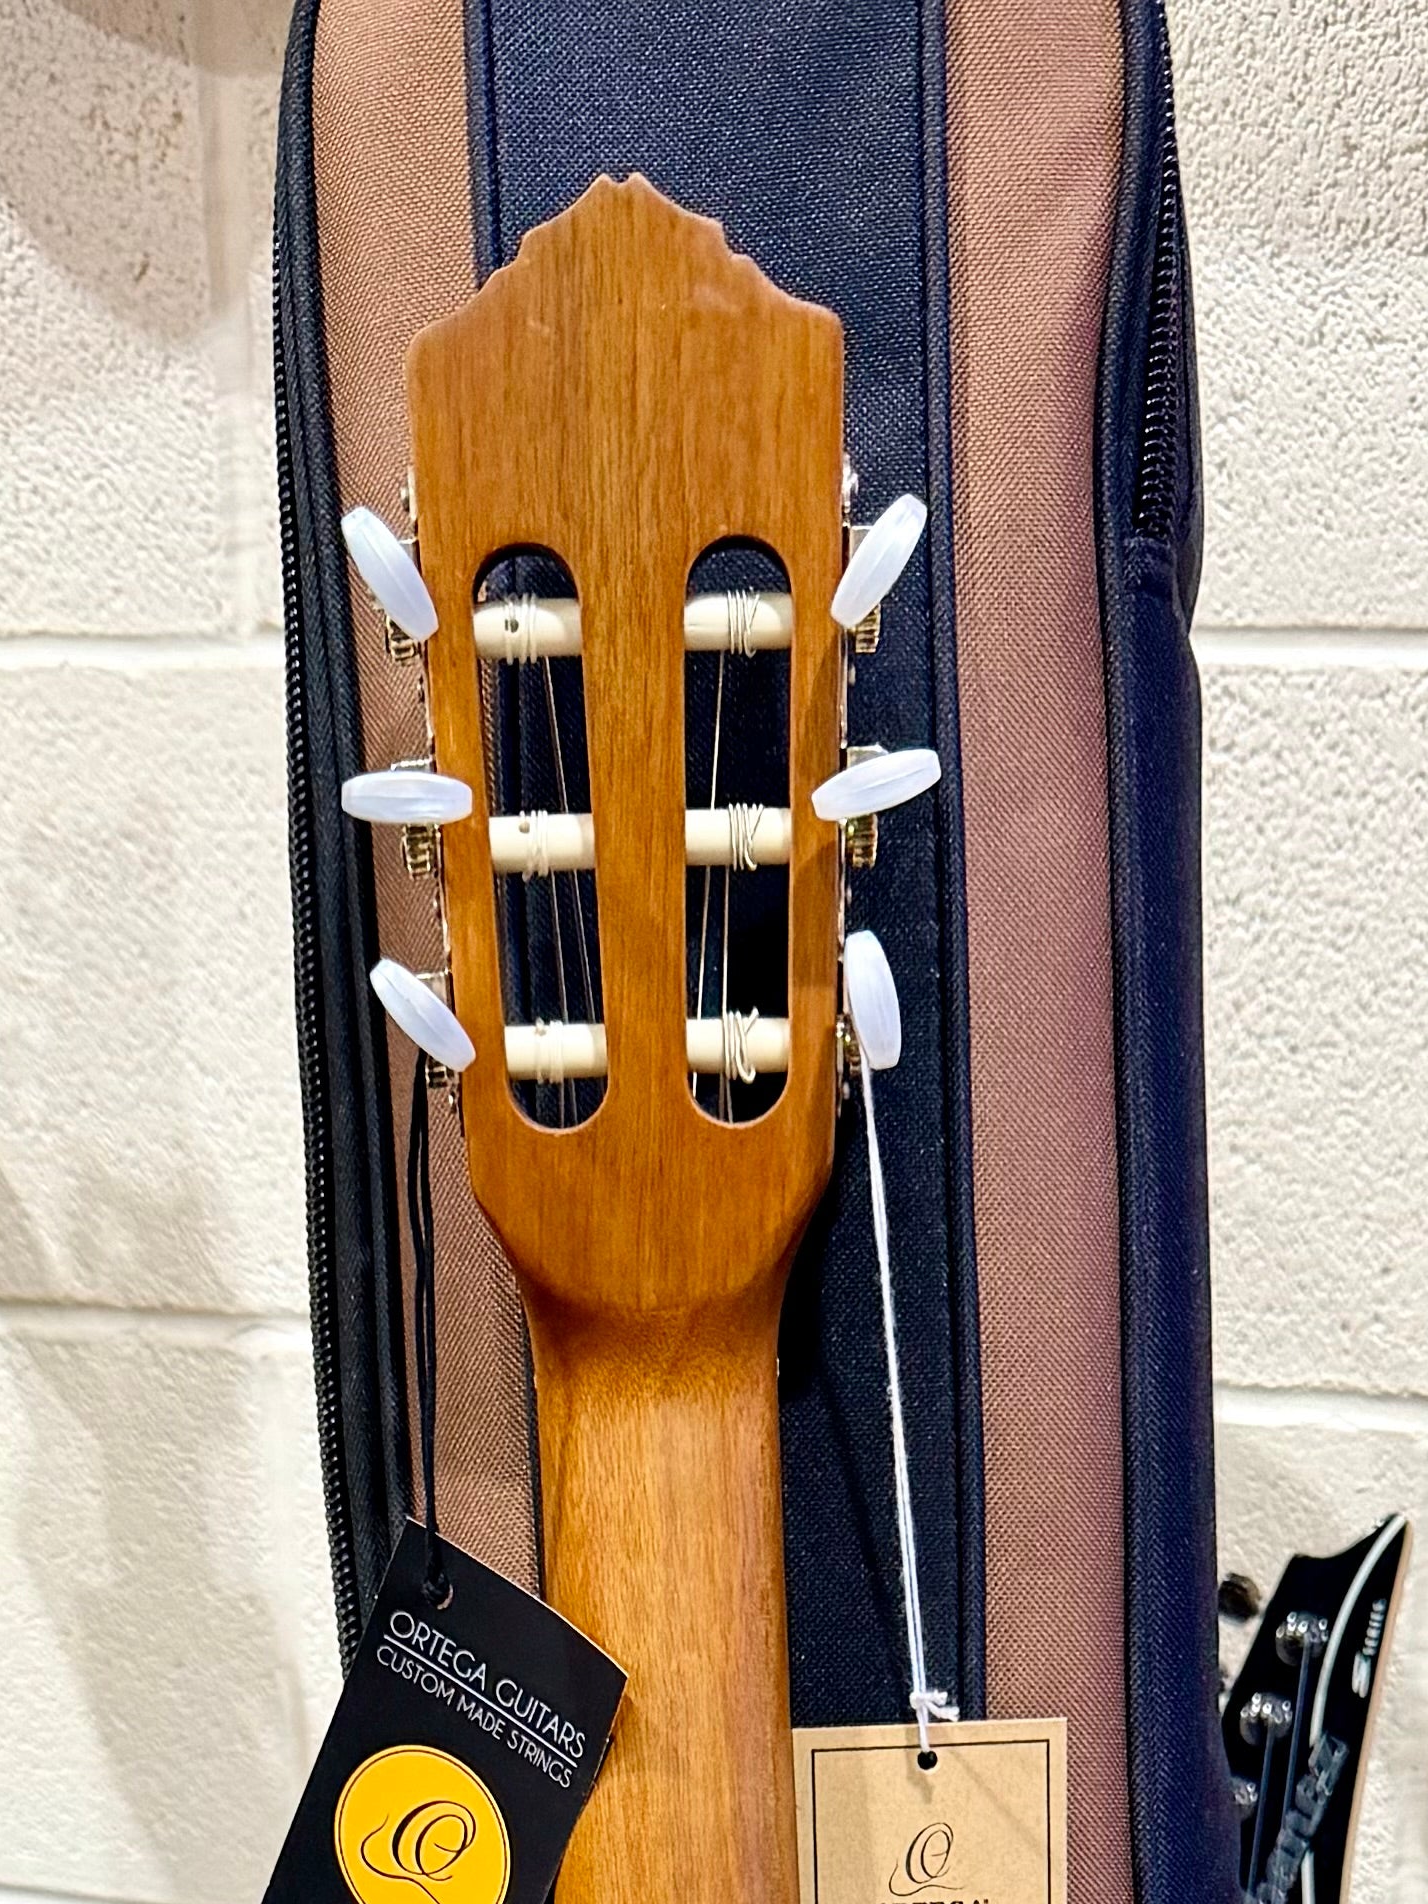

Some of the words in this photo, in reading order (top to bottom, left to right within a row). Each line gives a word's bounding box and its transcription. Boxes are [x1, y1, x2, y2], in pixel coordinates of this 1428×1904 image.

[376, 1647, 454, 1709] CUSTOM
[456, 1694, 505, 1740] MADE
[506, 1728, 574, 1790] STRINGS
[389, 1610, 486, 1693] ORTEGA
[496, 1676, 586, 1759] GUITARS
